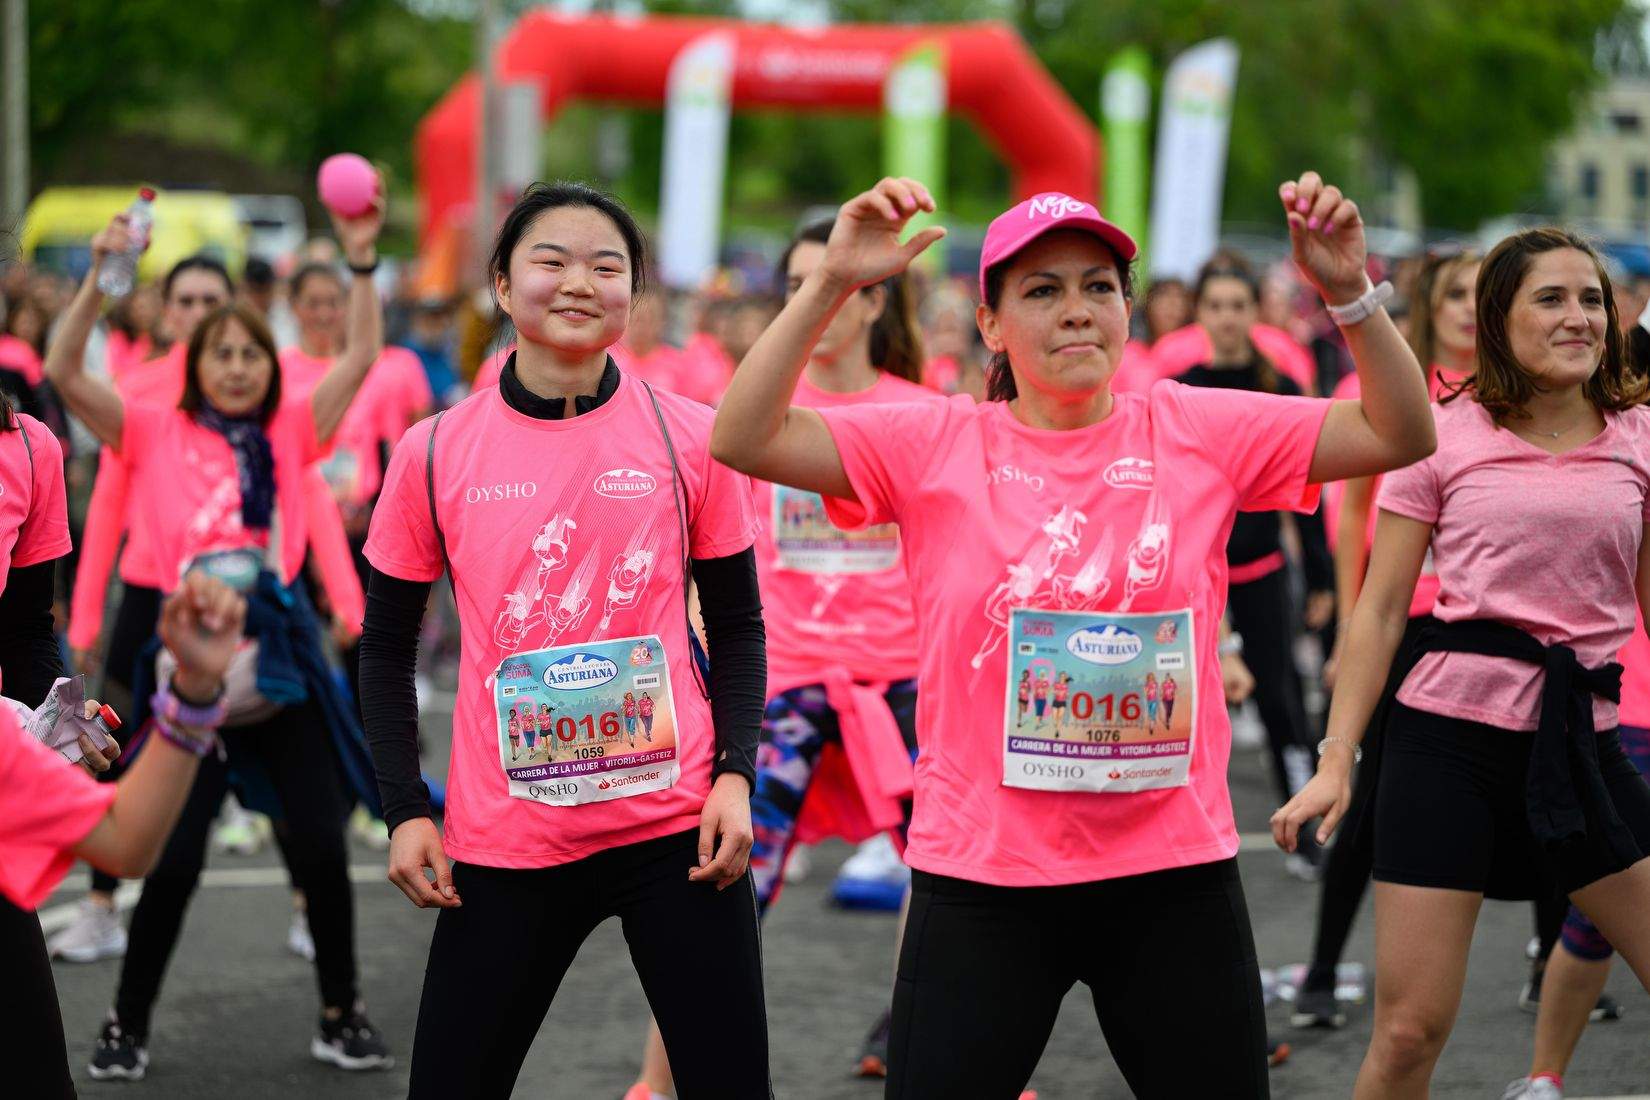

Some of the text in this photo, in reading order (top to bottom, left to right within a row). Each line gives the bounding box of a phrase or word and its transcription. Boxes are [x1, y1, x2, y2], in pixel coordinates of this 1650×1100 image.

[466, 481, 537, 504] OYSHO
[599, 479, 653, 491] ASTURIANA
[1071, 637, 1139, 654] ASTURIANA
[548, 667, 614, 685] ASTURIANA
[1071, 692, 1142, 722] 016
[555, 711, 621, 742] 016
[1086, 730, 1120, 742] 1076
[574, 746, 605, 760] 1059
[1011, 739, 1052, 753] CARRERA
[1053, 743, 1066, 753] DE
[1066, 744, 1079, 754] LA
[1080, 745, 1113, 755] MUJER
[511, 750, 673, 780] CARRERA DE LA MUJER VITORIA-GASTEIZ
[1023, 762, 1173, 781] OYSHO Santander
[528, 770, 661, 799] OYSHO Santander
